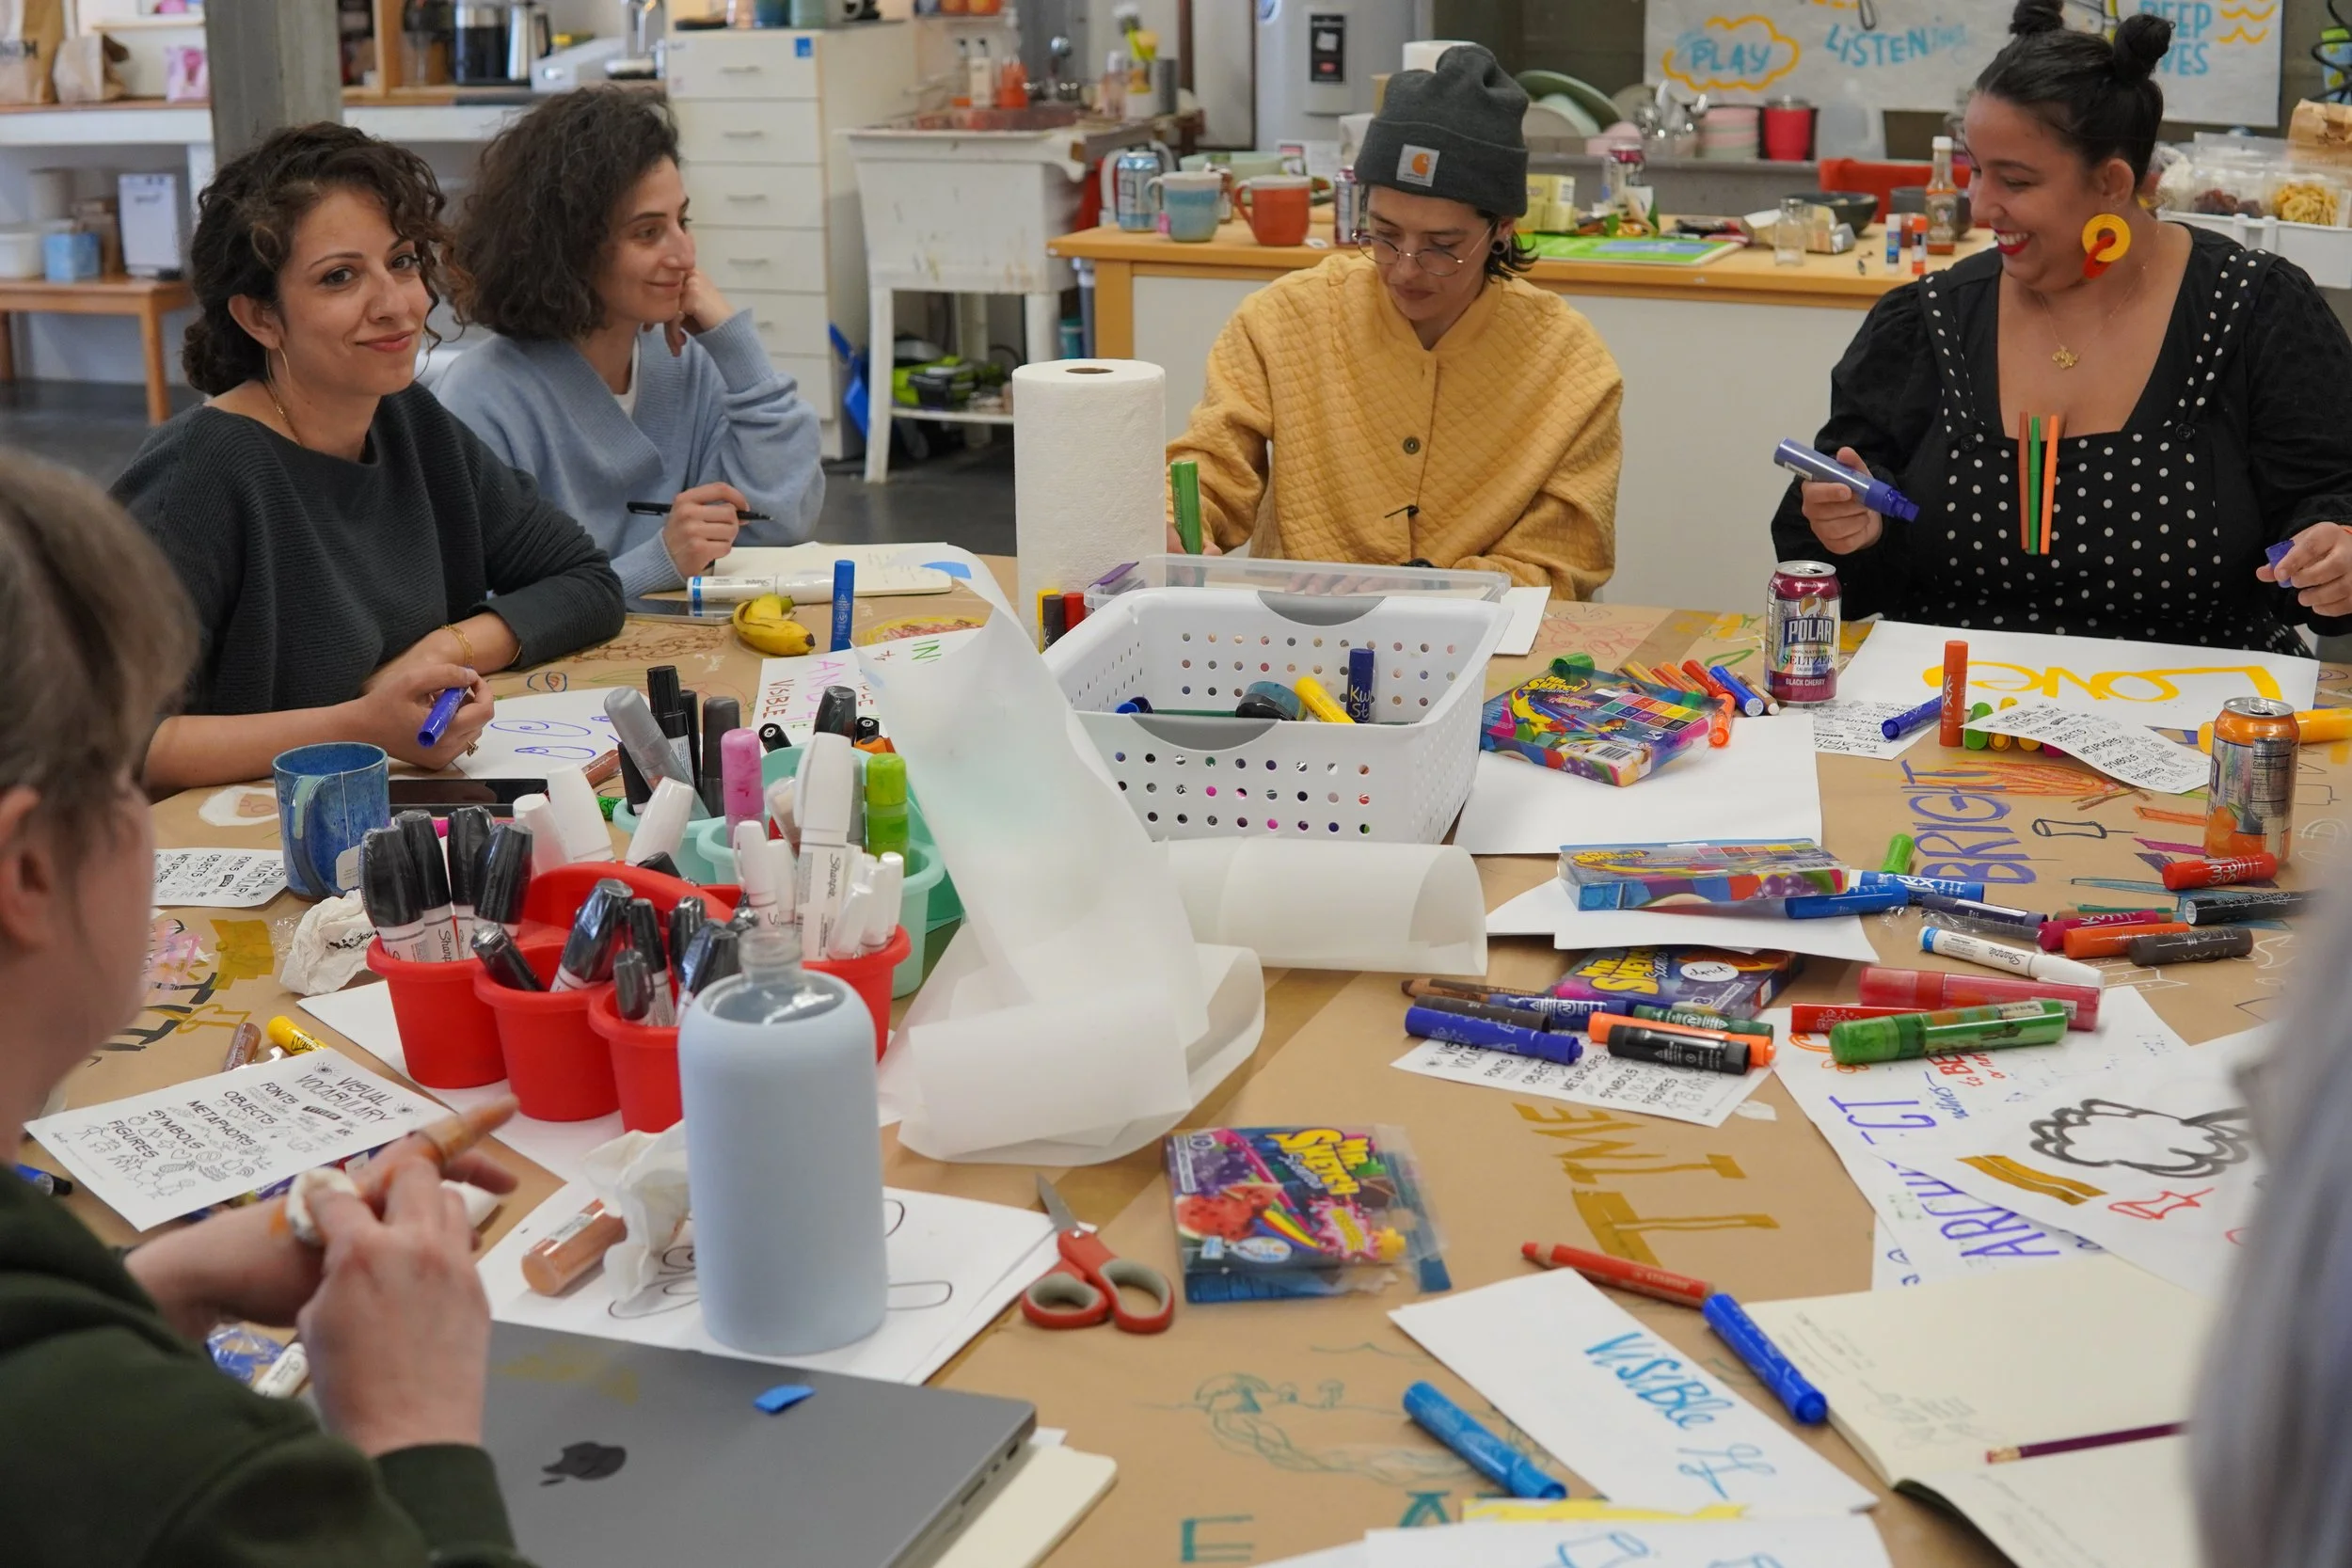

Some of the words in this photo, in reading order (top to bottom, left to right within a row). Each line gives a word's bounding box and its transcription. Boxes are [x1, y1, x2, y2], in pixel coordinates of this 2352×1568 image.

[1691, 40, 1771, 74] PLAY
[2158, 44, 2209, 76] VES
[1788, 619, 1834, 643] POLAR
[1782, 654, 1834, 666] SELTZER
[1804, 678, 1826, 687] CHERRY
[762, 678, 795, 720] VISIBLE
[2052, 729, 2087, 742] OBJECTS
[2077, 737, 2122, 755] METAPHORS
[2103, 753, 2138, 769] SYMBOLS
[1900, 759, 2037, 884] BRIGHT
[828, 853, 841, 898] Sharpie
[438, 928, 453, 962] Sharp
[1987, 946, 2027, 966] Sharpie
[1484, 1058, 1513, 1077] FONTS
[1521, 1061, 1554, 1085] OBJECT
[1560, 1053, 1608, 1091] METAPHORS
[260, 1082, 299, 1105] FONTS
[294, 1074, 395, 1124] VOCABULARY
[336, 1076, 393, 1107] VISUAL
[1599, 1069, 1639, 1099] SYMBOLS
[1641, 1077, 1678, 1104] FIGURES
[224, 1090, 278, 1125] OBJECTS
[107, 1119, 160, 1159] FIGURES
[148, 1109, 206, 1150] SYMBOLS
[186, 1100, 256, 1147] METAPHORS
